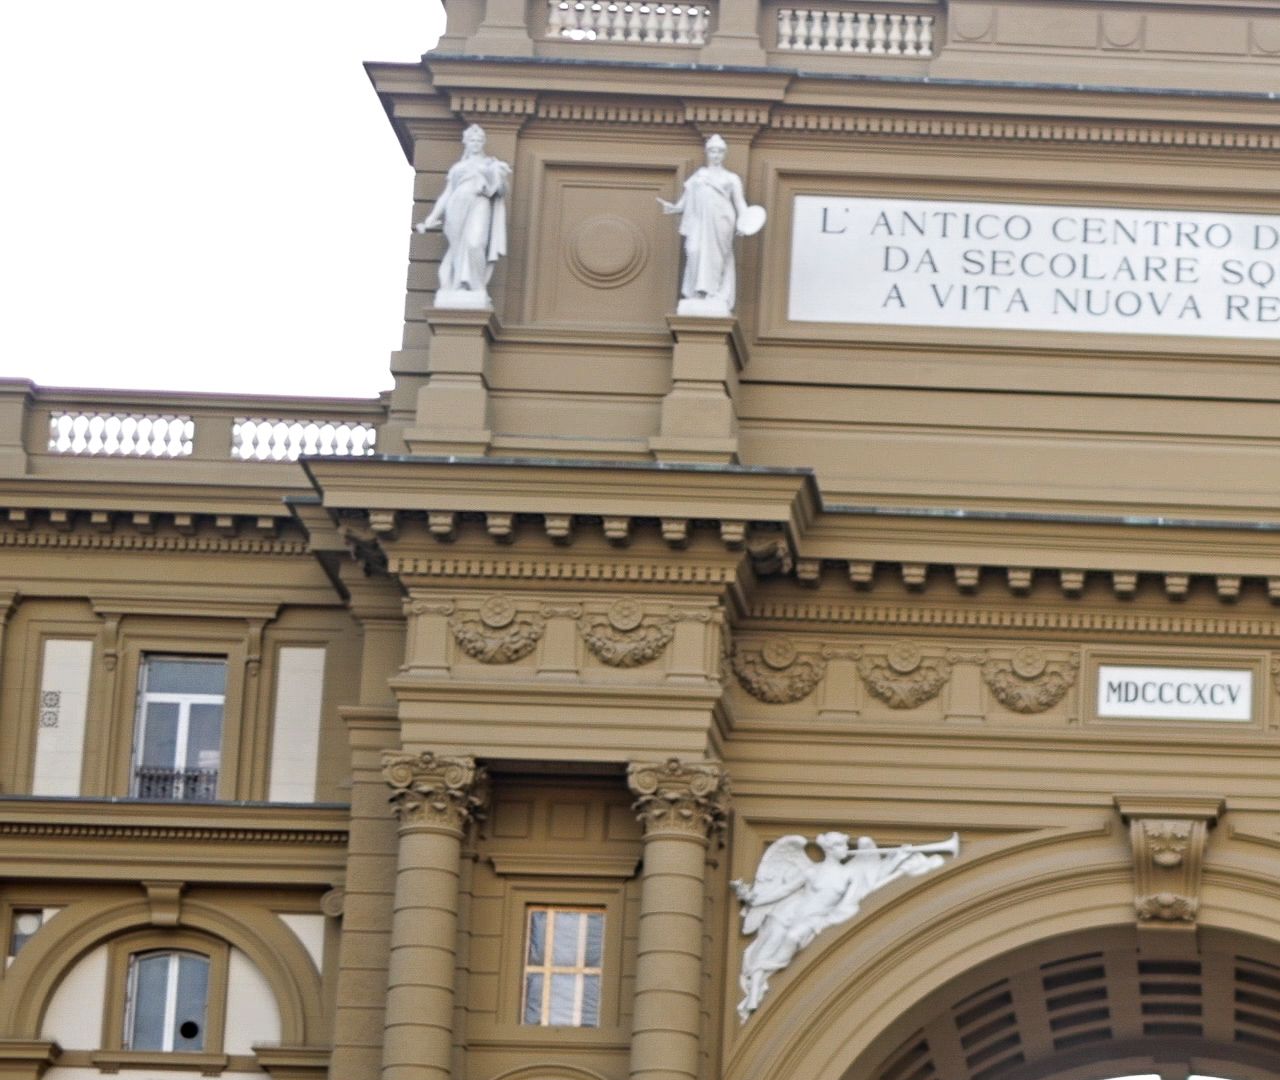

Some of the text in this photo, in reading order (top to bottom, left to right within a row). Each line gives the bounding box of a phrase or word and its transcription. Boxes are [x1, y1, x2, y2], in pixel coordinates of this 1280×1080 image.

[870, 209, 1032, 241] ANTICO
[1052, 216, 1232, 249] CENTRO
[883, 245, 940, 275] DA
[962, 249, 1199, 284] SECOLARE
[881, 282, 907, 309] A
[930, 283, 1030, 313] VITA
[1052, 288, 1202, 320] NUOVA
[1105, 680, 1241, 706] MDCCCXCV
